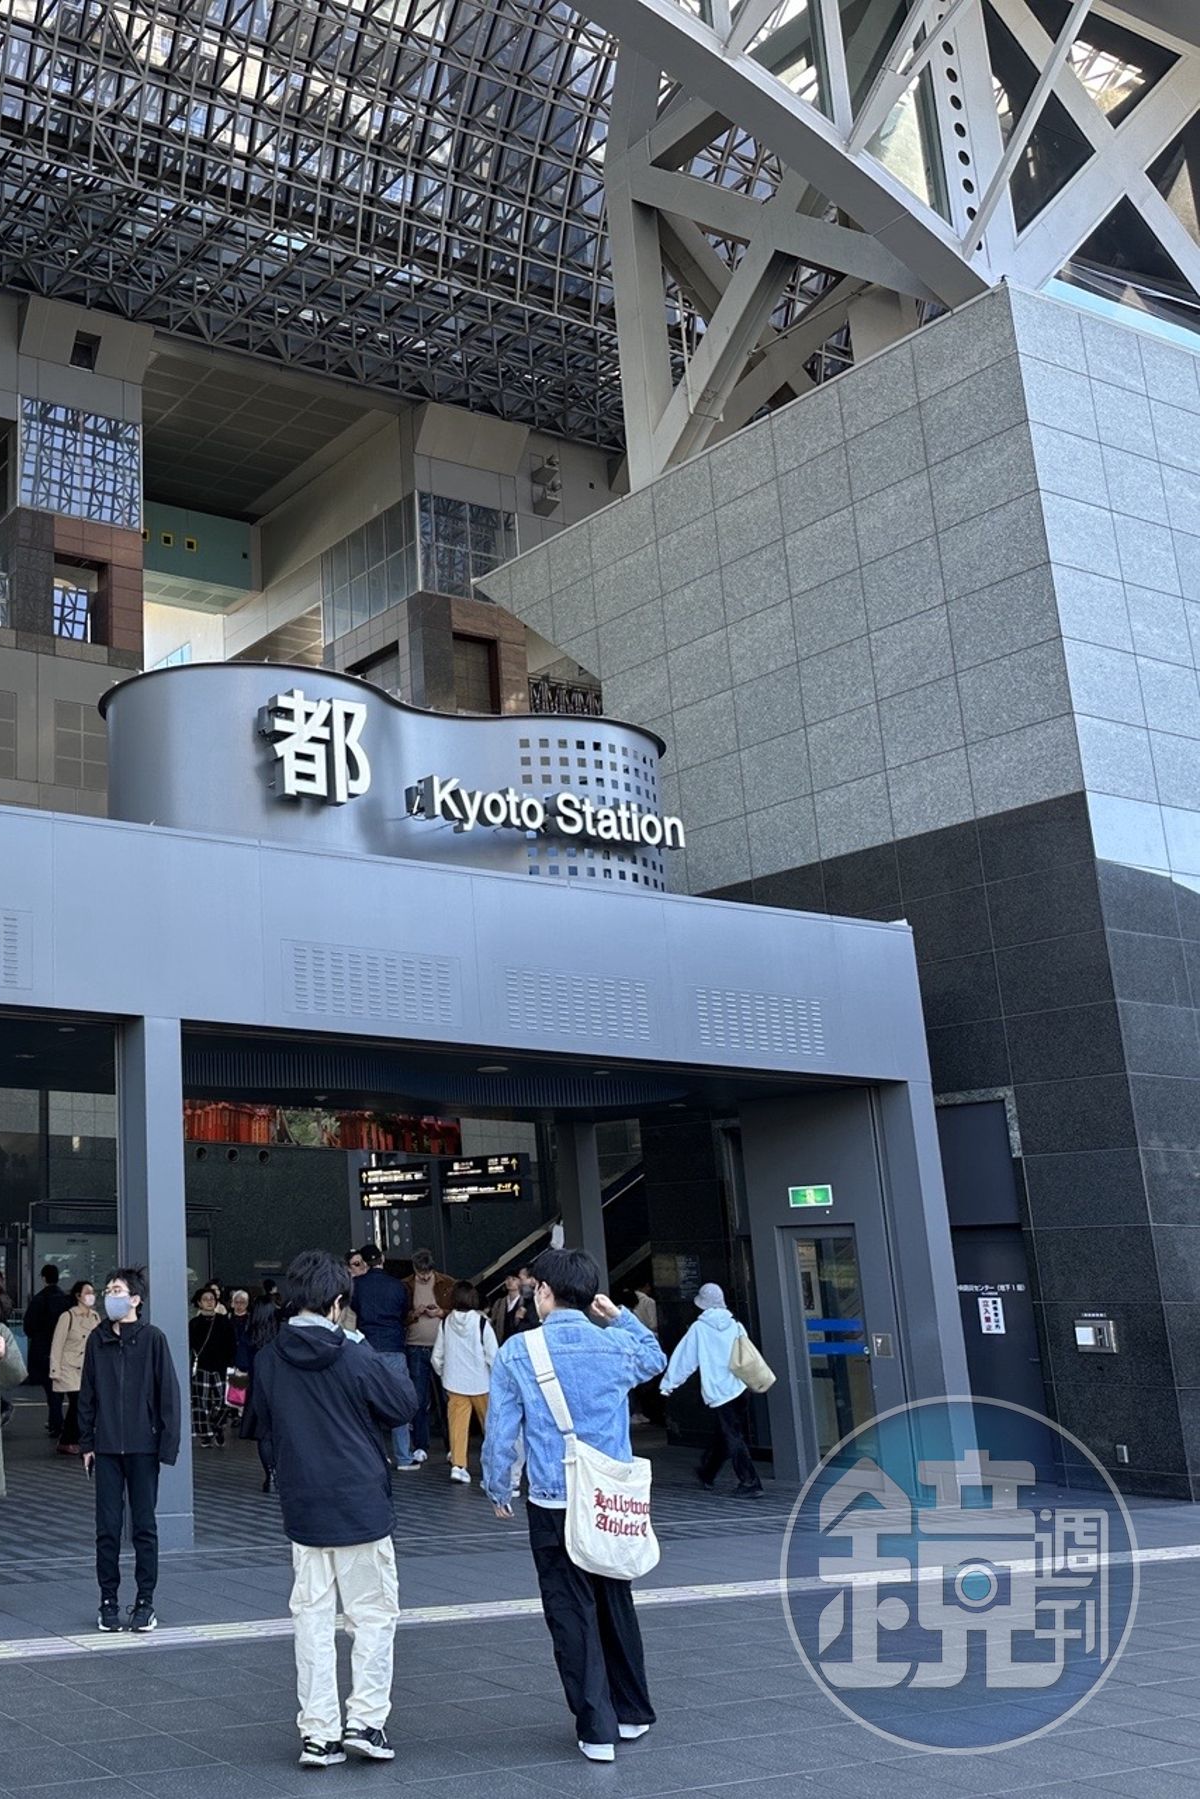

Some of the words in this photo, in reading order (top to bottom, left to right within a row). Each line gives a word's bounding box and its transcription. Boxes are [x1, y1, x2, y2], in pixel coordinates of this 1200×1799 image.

[267, 688, 371, 805] 都
[430, 775, 544, 832] Kyoto
[555, 792, 686, 850] Station
